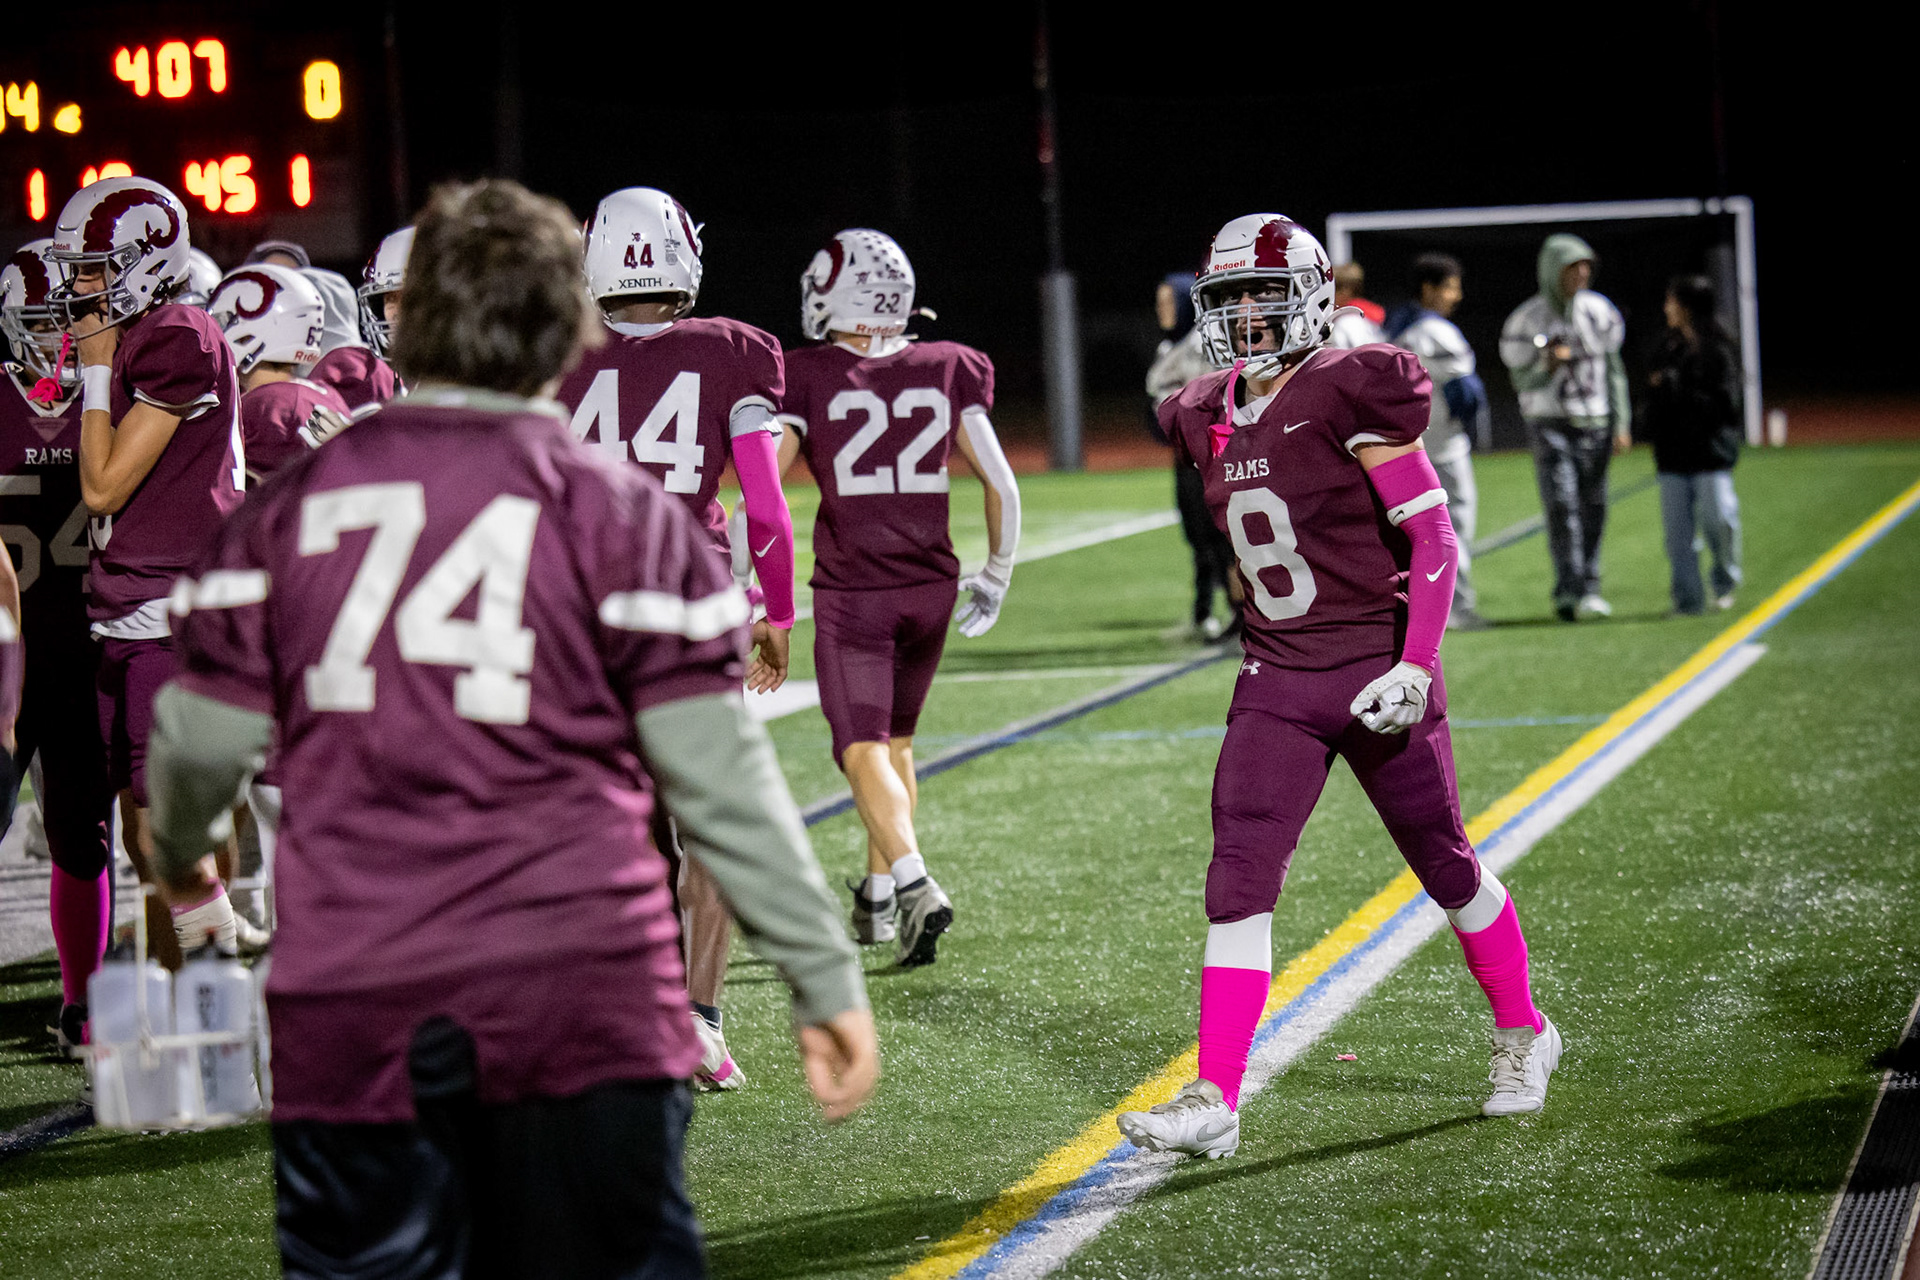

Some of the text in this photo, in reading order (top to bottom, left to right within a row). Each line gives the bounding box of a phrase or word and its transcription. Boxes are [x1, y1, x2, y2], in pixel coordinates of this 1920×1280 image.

[0, 81, 40, 133] 4
[303, 60, 342, 120] 0
[28, 168, 46, 221] 1
[185, 155, 257, 213] 45
[290, 154, 311, 207] 1
[623, 243, 655, 269] 44
[1214, 260, 1246, 271] Riddell
[618, 277, 663, 289] XENITH
[873, 292, 901, 314] 22
[25, 448, 73, 465] RAMS
[568, 368, 705, 495] 44
[827, 389, 951, 496] 22
[1223, 457, 1271, 483] RAMS
[1226, 486, 1318, 622] 8
[298, 480, 542, 726] 74
